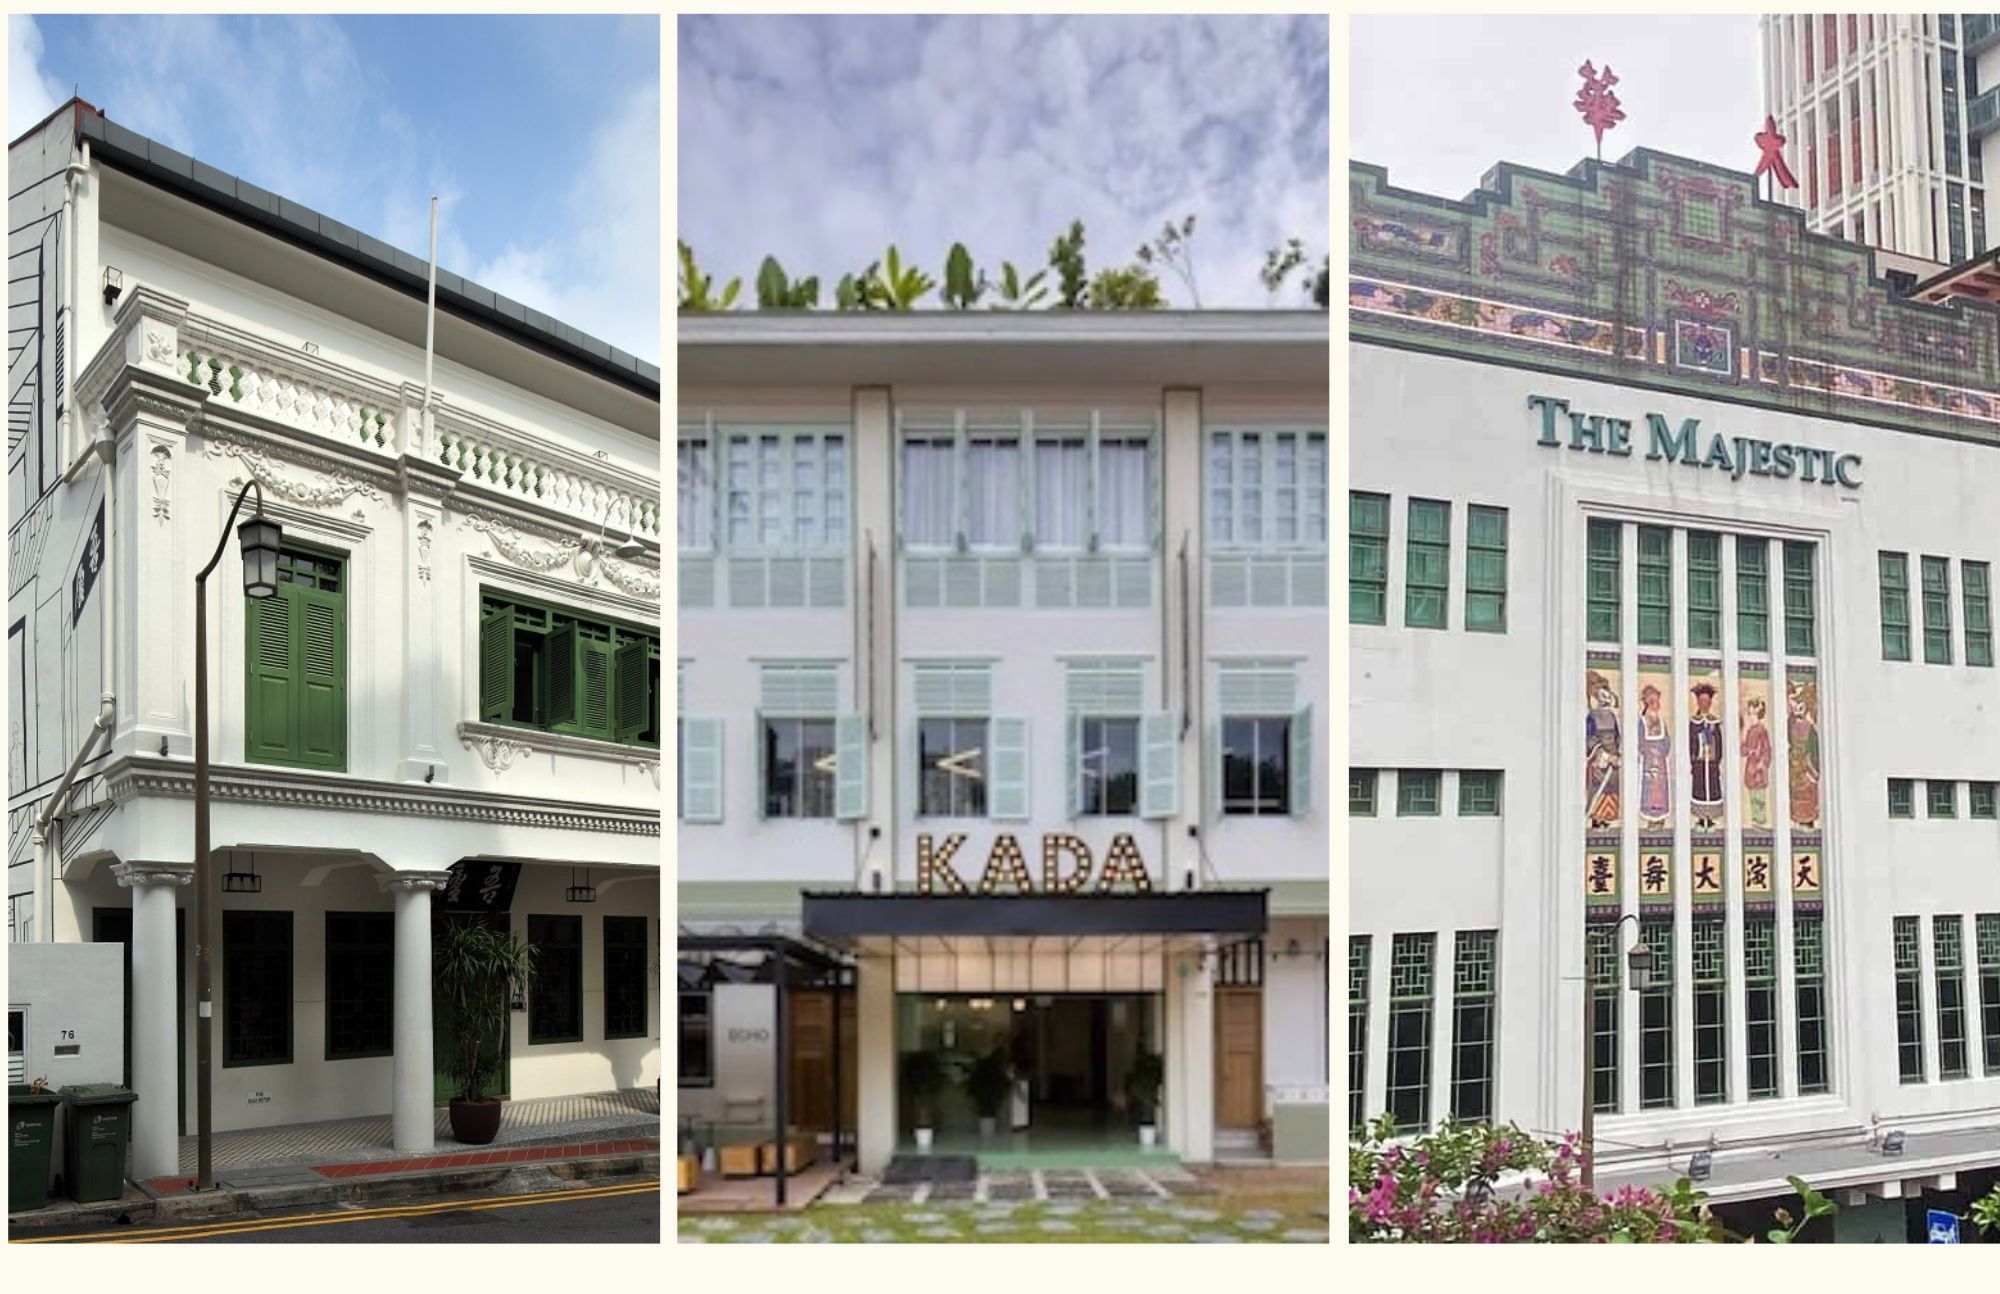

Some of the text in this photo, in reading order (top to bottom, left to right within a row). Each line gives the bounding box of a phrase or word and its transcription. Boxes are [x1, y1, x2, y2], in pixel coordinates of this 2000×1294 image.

[916, 833, 1152, 895] KADA
[61, 1030, 75, 1040] 76
[728, 1028, 769, 1042] ECHO
